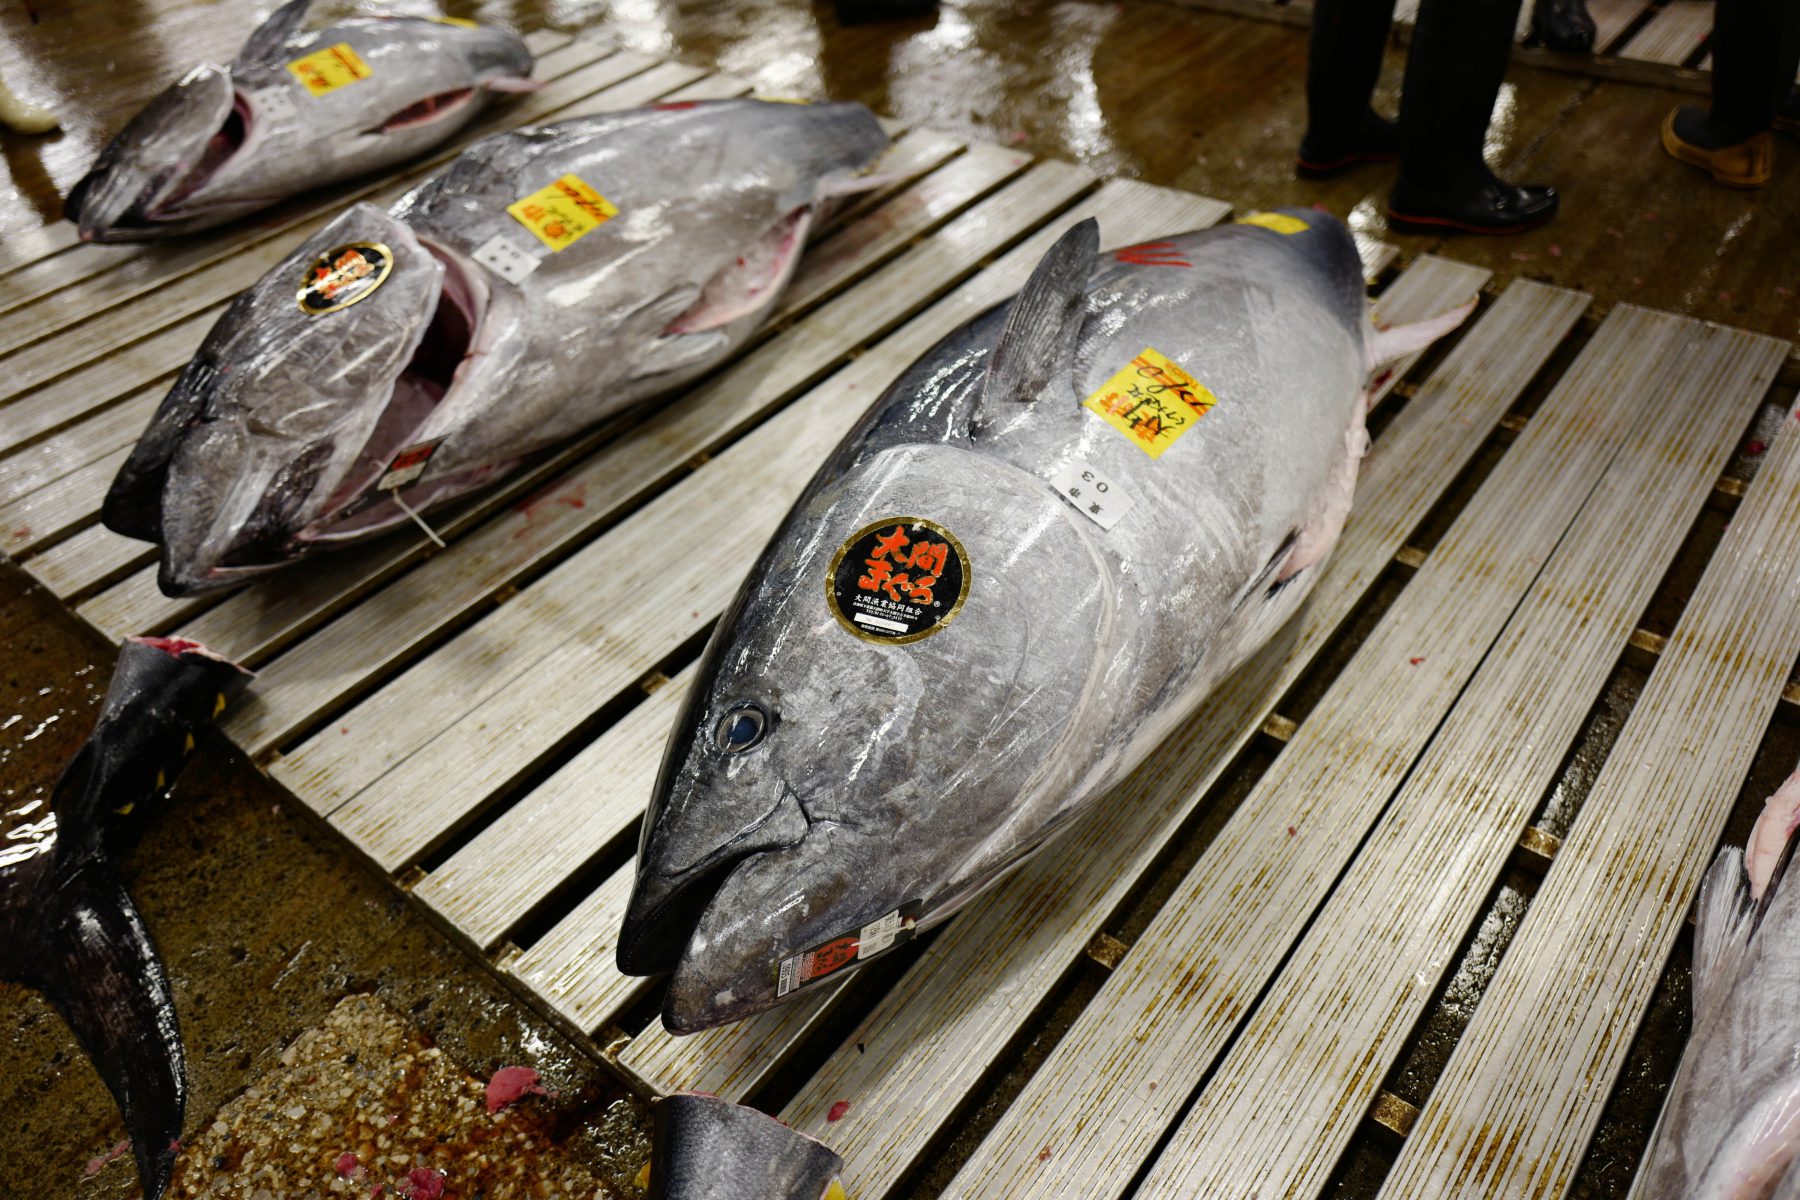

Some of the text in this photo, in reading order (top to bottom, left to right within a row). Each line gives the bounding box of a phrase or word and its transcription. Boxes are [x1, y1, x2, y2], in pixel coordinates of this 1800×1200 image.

[1081, 471, 1108, 493] 03
[1069, 488, 1104, 514] 東市
[871, 526, 948, 577] 大間
[858, 558, 937, 606] まぐろ
